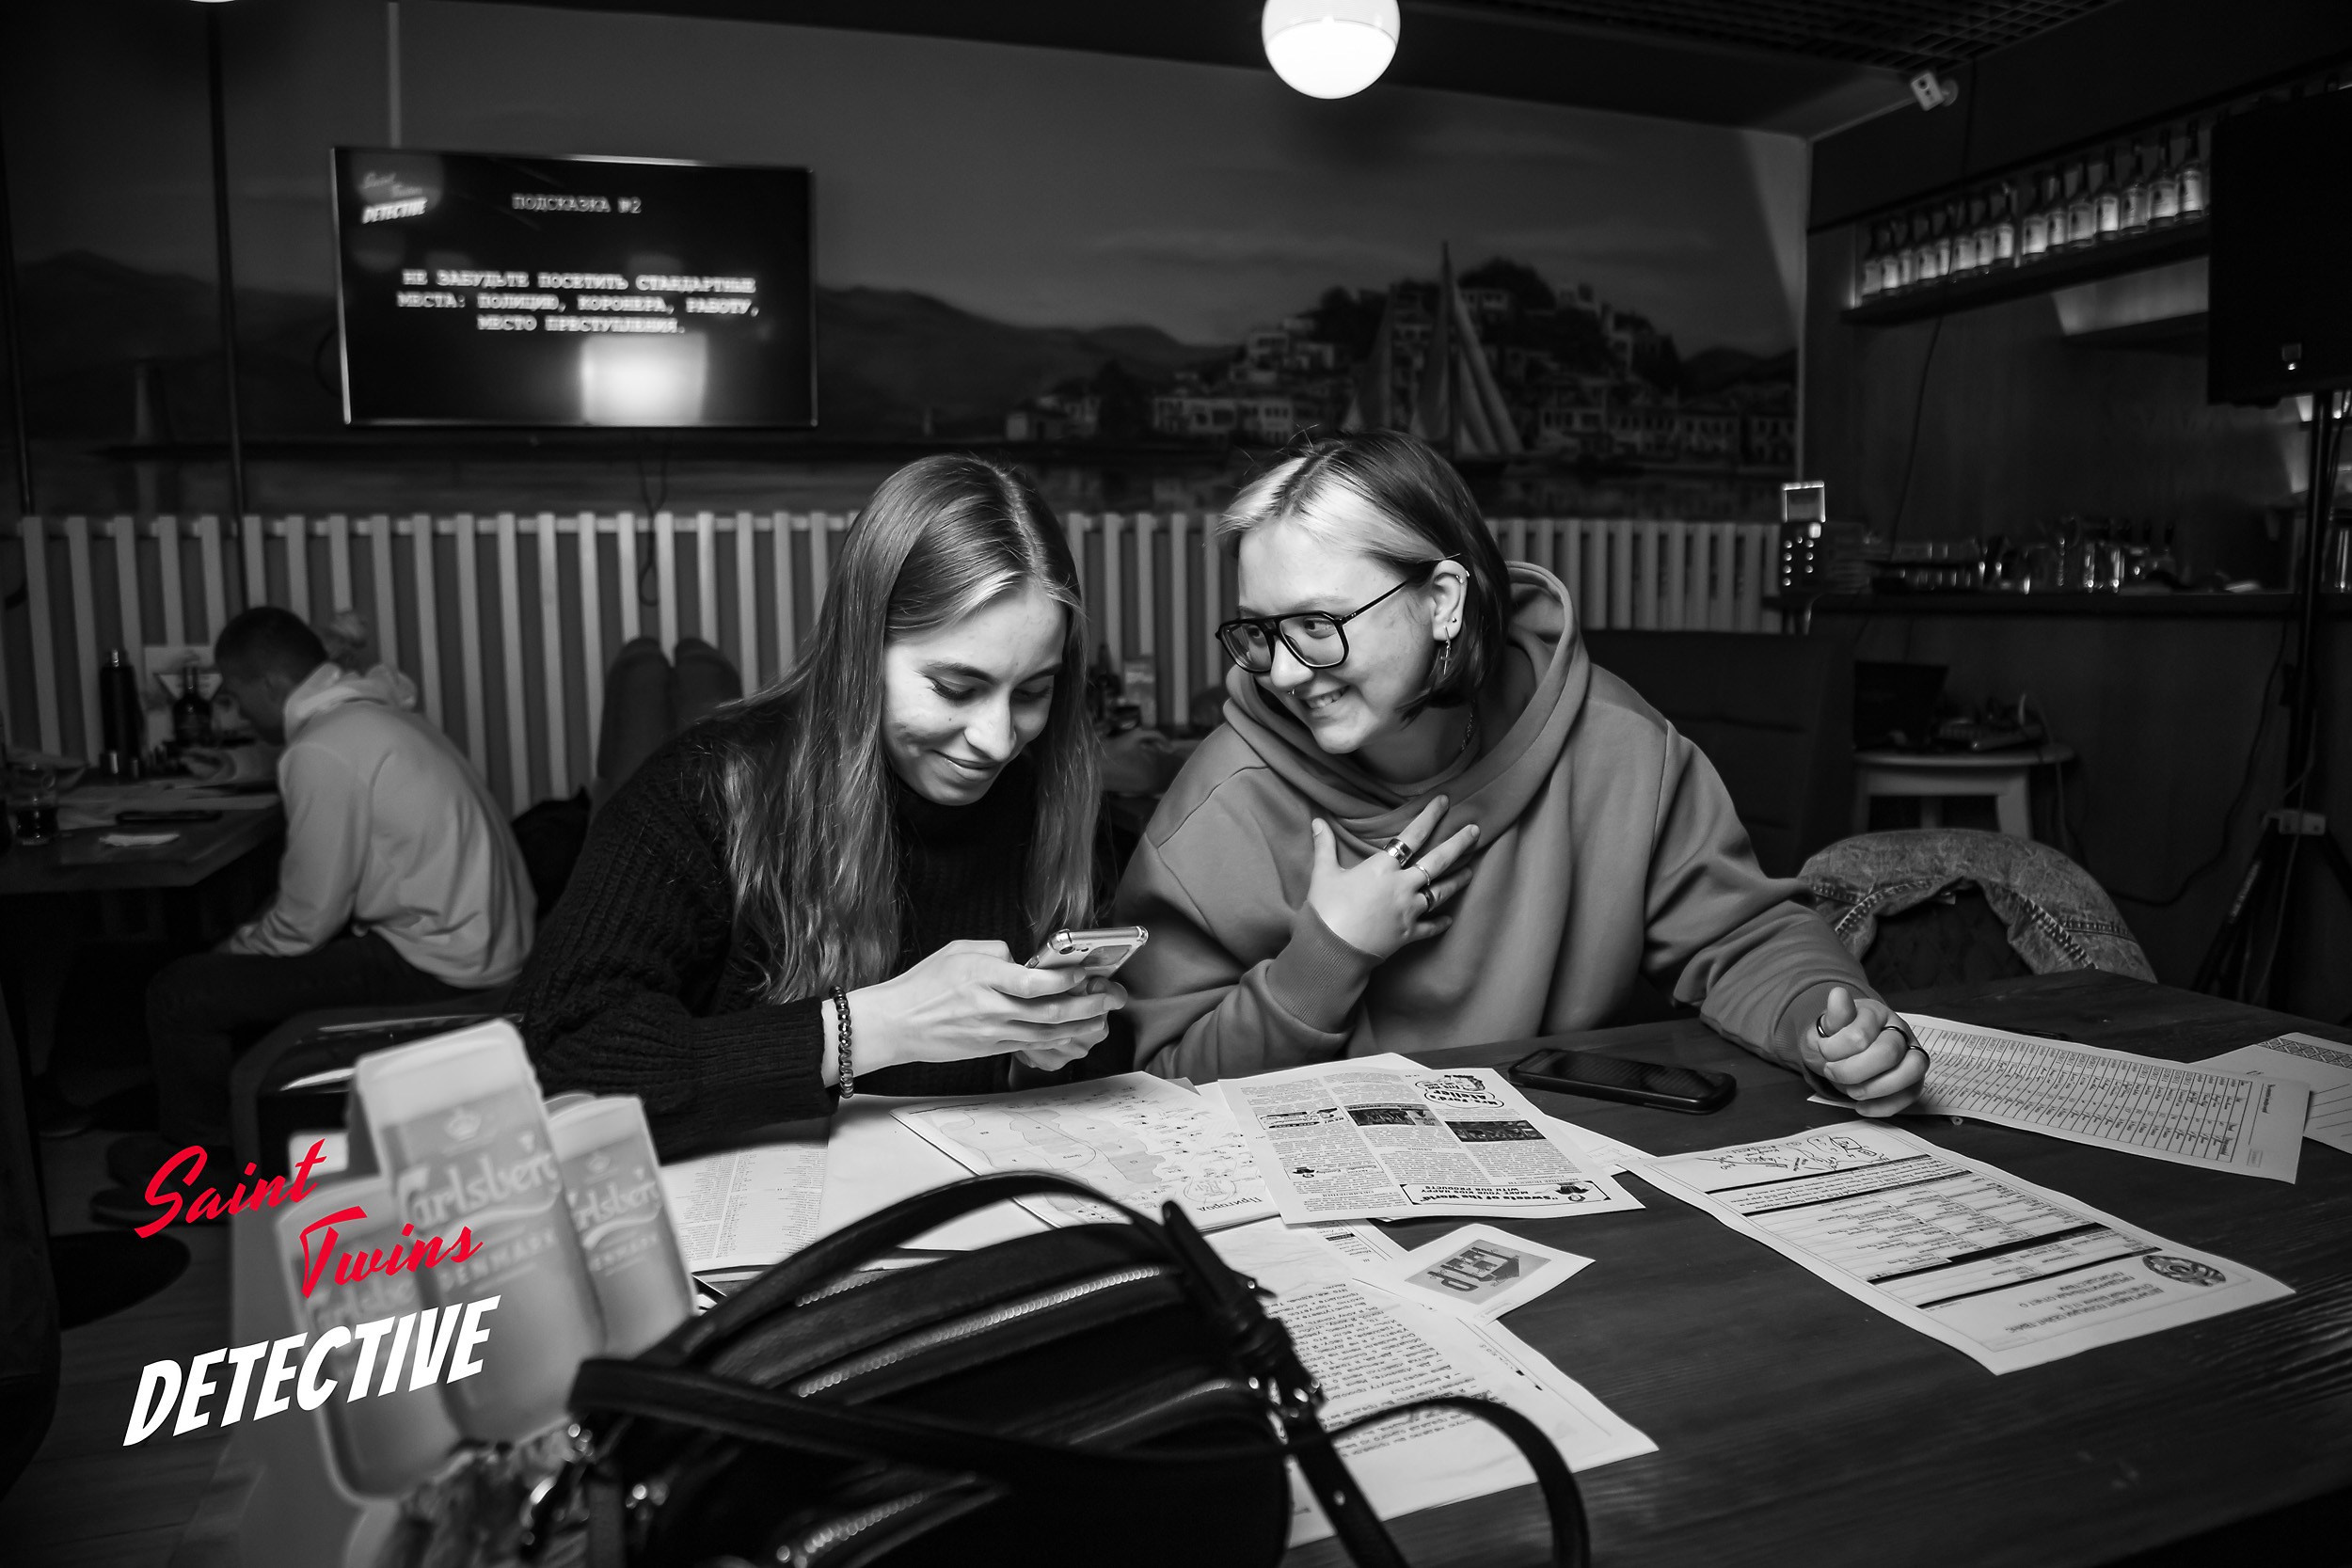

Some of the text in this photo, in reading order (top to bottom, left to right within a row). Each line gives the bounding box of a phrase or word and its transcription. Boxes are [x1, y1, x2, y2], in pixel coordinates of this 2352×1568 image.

[512, 193, 612, 213] ПОДСКАЗКА
[402, 268, 428, 286] НЕ
[437, 269, 530, 289] ЗАБУДЬТЕ
[537, 272, 629, 290] ПОСЕТИТЬ
[396, 291, 466, 309] МЕСТА:
[476, 313, 537, 331] МЕСТО
[1196, 1196, 1263, 1212] Пригород
